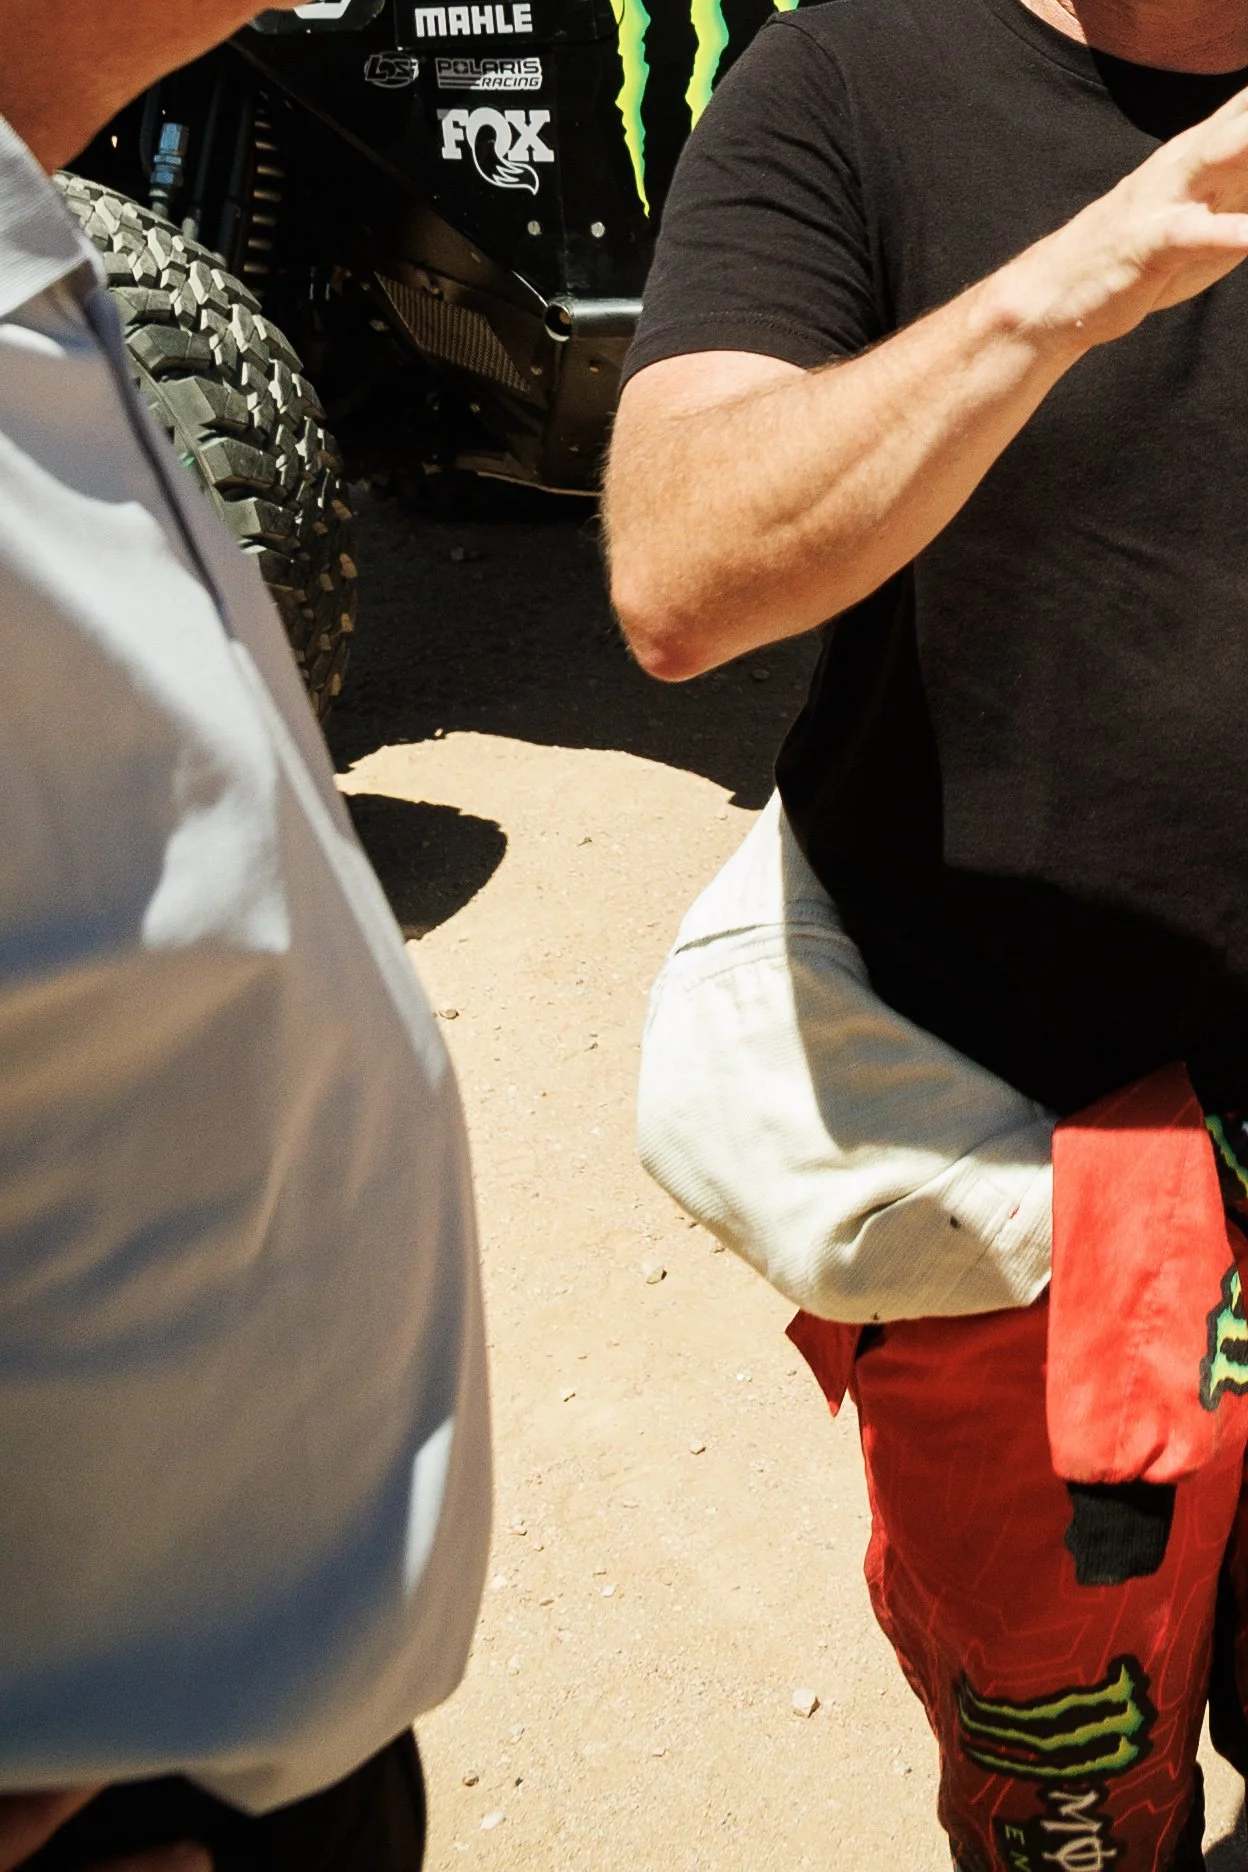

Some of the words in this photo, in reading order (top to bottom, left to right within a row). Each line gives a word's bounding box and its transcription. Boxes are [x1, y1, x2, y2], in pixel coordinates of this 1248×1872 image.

[415, 4, 533, 37] MAHLE
[437, 58, 540, 75] POLARIS
[481, 77, 540, 89] RACING
[438, 107, 555, 176] FOX
